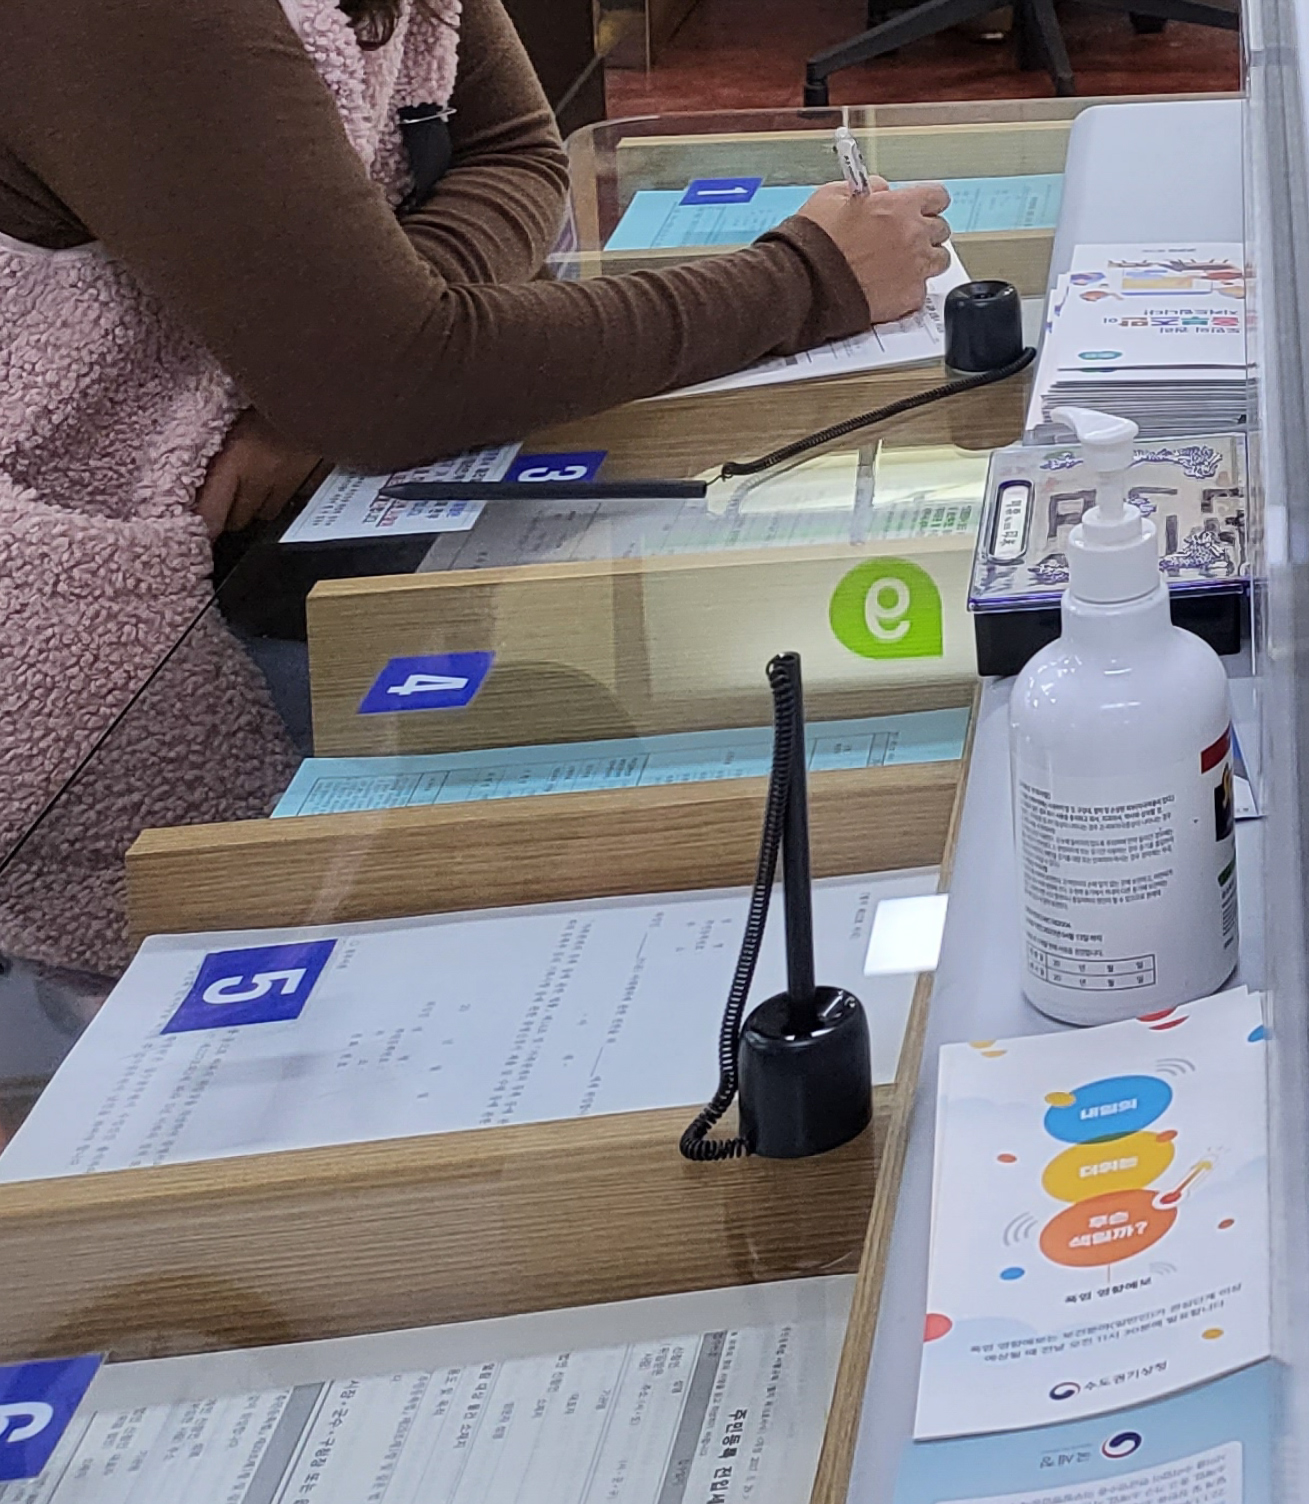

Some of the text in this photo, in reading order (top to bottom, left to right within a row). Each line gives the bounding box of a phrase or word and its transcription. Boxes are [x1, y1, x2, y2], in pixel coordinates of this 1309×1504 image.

[697, 186, 748, 196] 1
[518, 465, 587, 483] 3
[387, 673, 469, 695] 4
[202, 969, 307, 1006] 5
[1080, 1098, 1138, 1120] 내일의
[1079, 1156, 1138, 1178] 더위는
[1068, 1220, 1148, 1248] 색일까?
[1084, 1360, 1168, 1391] 수도권기상청
[300, 1380, 360, 1494] 시장 군수 구청장 또는
[718, 1409, 748, 1458] 주민등록
